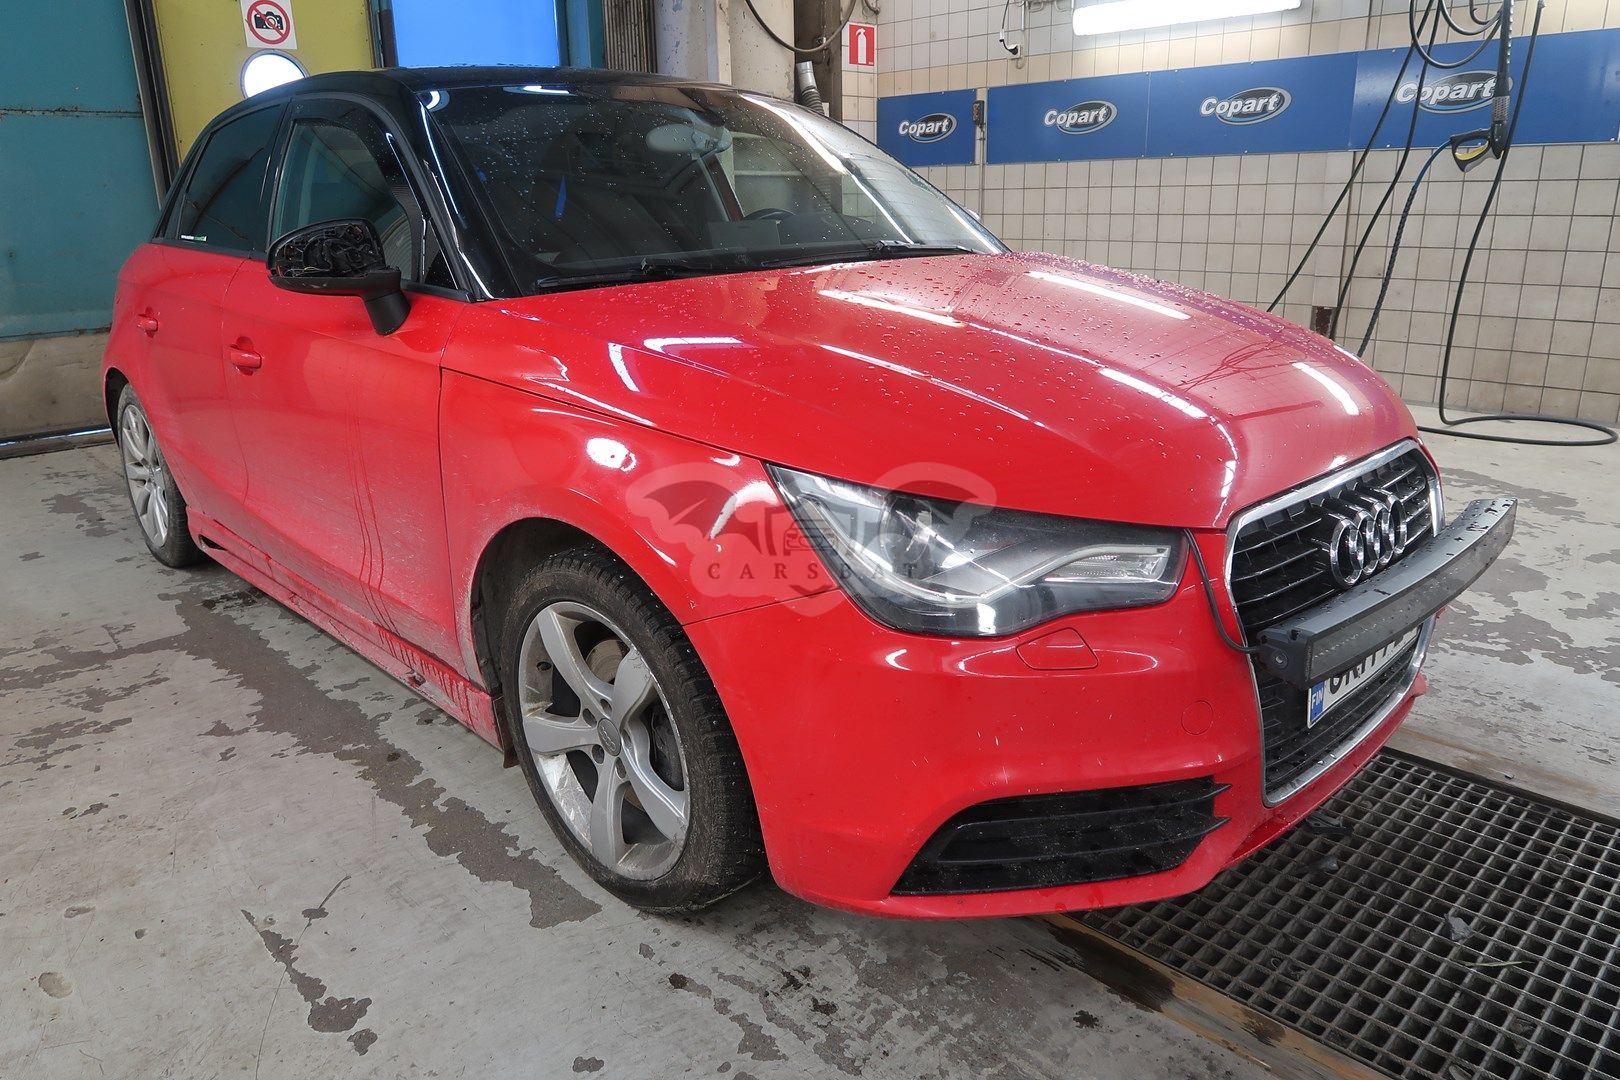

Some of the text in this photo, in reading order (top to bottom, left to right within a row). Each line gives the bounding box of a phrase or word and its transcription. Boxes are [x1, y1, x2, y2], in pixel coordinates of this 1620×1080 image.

[1397, 78, 1497, 105] Copart
[1044, 105, 1107, 128] Copart
[1200, 94, 1279, 118] Copart
[898, 117, 950, 137] Copart
[1311, 687, 1324, 709] FIN
